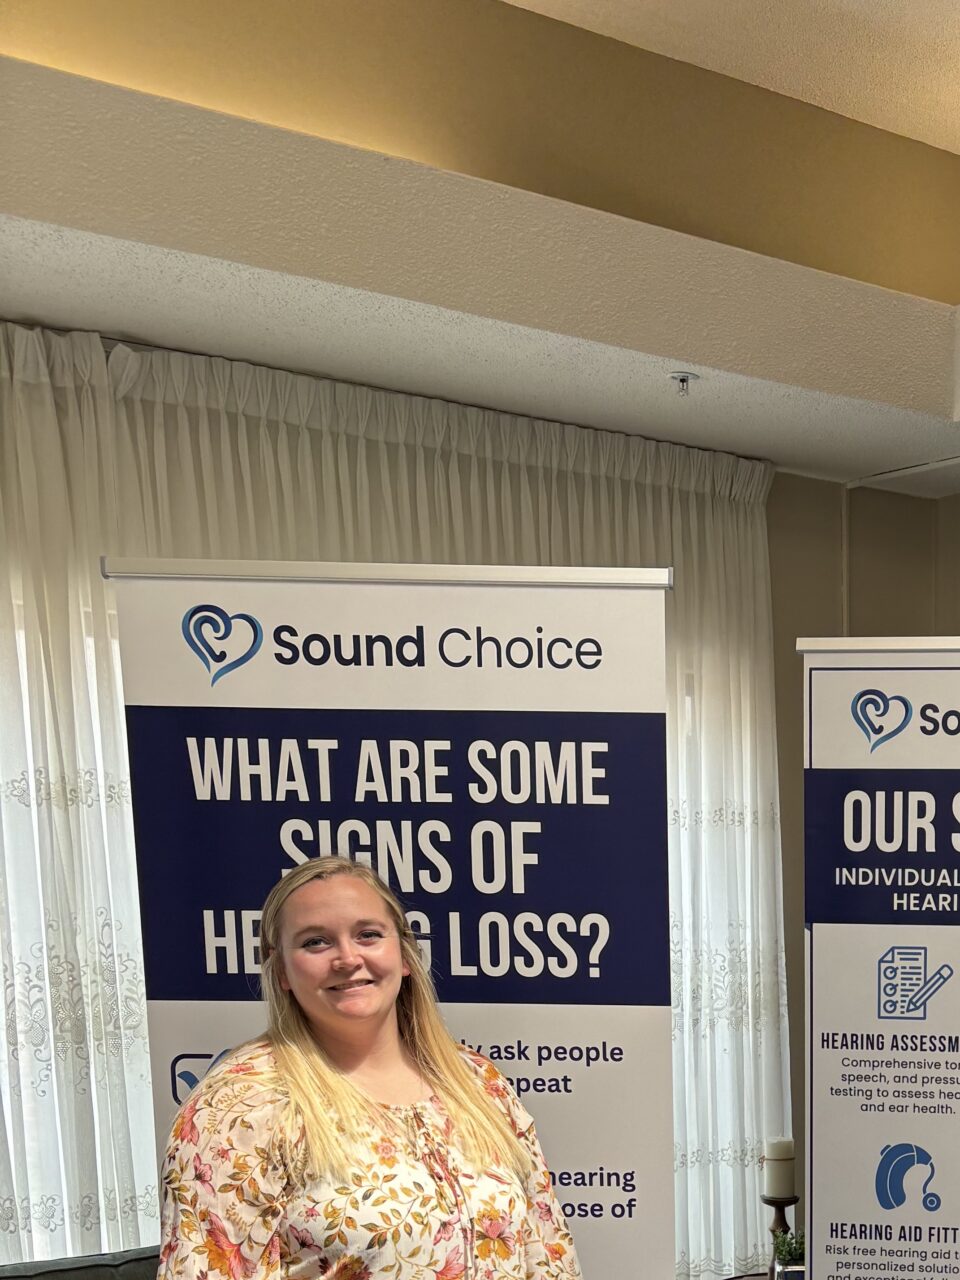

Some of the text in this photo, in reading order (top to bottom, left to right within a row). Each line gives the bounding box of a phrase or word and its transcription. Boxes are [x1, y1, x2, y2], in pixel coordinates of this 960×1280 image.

[273, 625, 602, 669] Sound Choice
[186, 737, 609, 804] WHAT ARE SOME
[843, 790, 936, 853] OUR
[280, 819, 541, 894] SIGNS OF
[449, 912, 610, 978] LOSS?
[821, 1032, 884, 1051] HEARING
[489, 1040, 623, 1067] ask people
[841, 1057, 941, 1073] Comprehensive
[841, 1072, 890, 1085] speech,
[893, 1074, 918, 1084] and
[830, 1086, 873, 1100] testing
[876, 1088, 889, 1098] to
[892, 1090, 935, 1099] assess
[860, 1102, 956, 1114] and ear health.
[611, 1198, 637, 1218] of
[830, 1222, 892, 1241] HEARING
[898, 1225, 922, 1242] AID
[825, 1244, 849, 1255] Risk
[852, 1245, 876, 1256] free
[880, 1246, 927, 1262] hearing
[931, 1249, 951, 1260] aid
[836, 1261, 915, 1274] personalized
